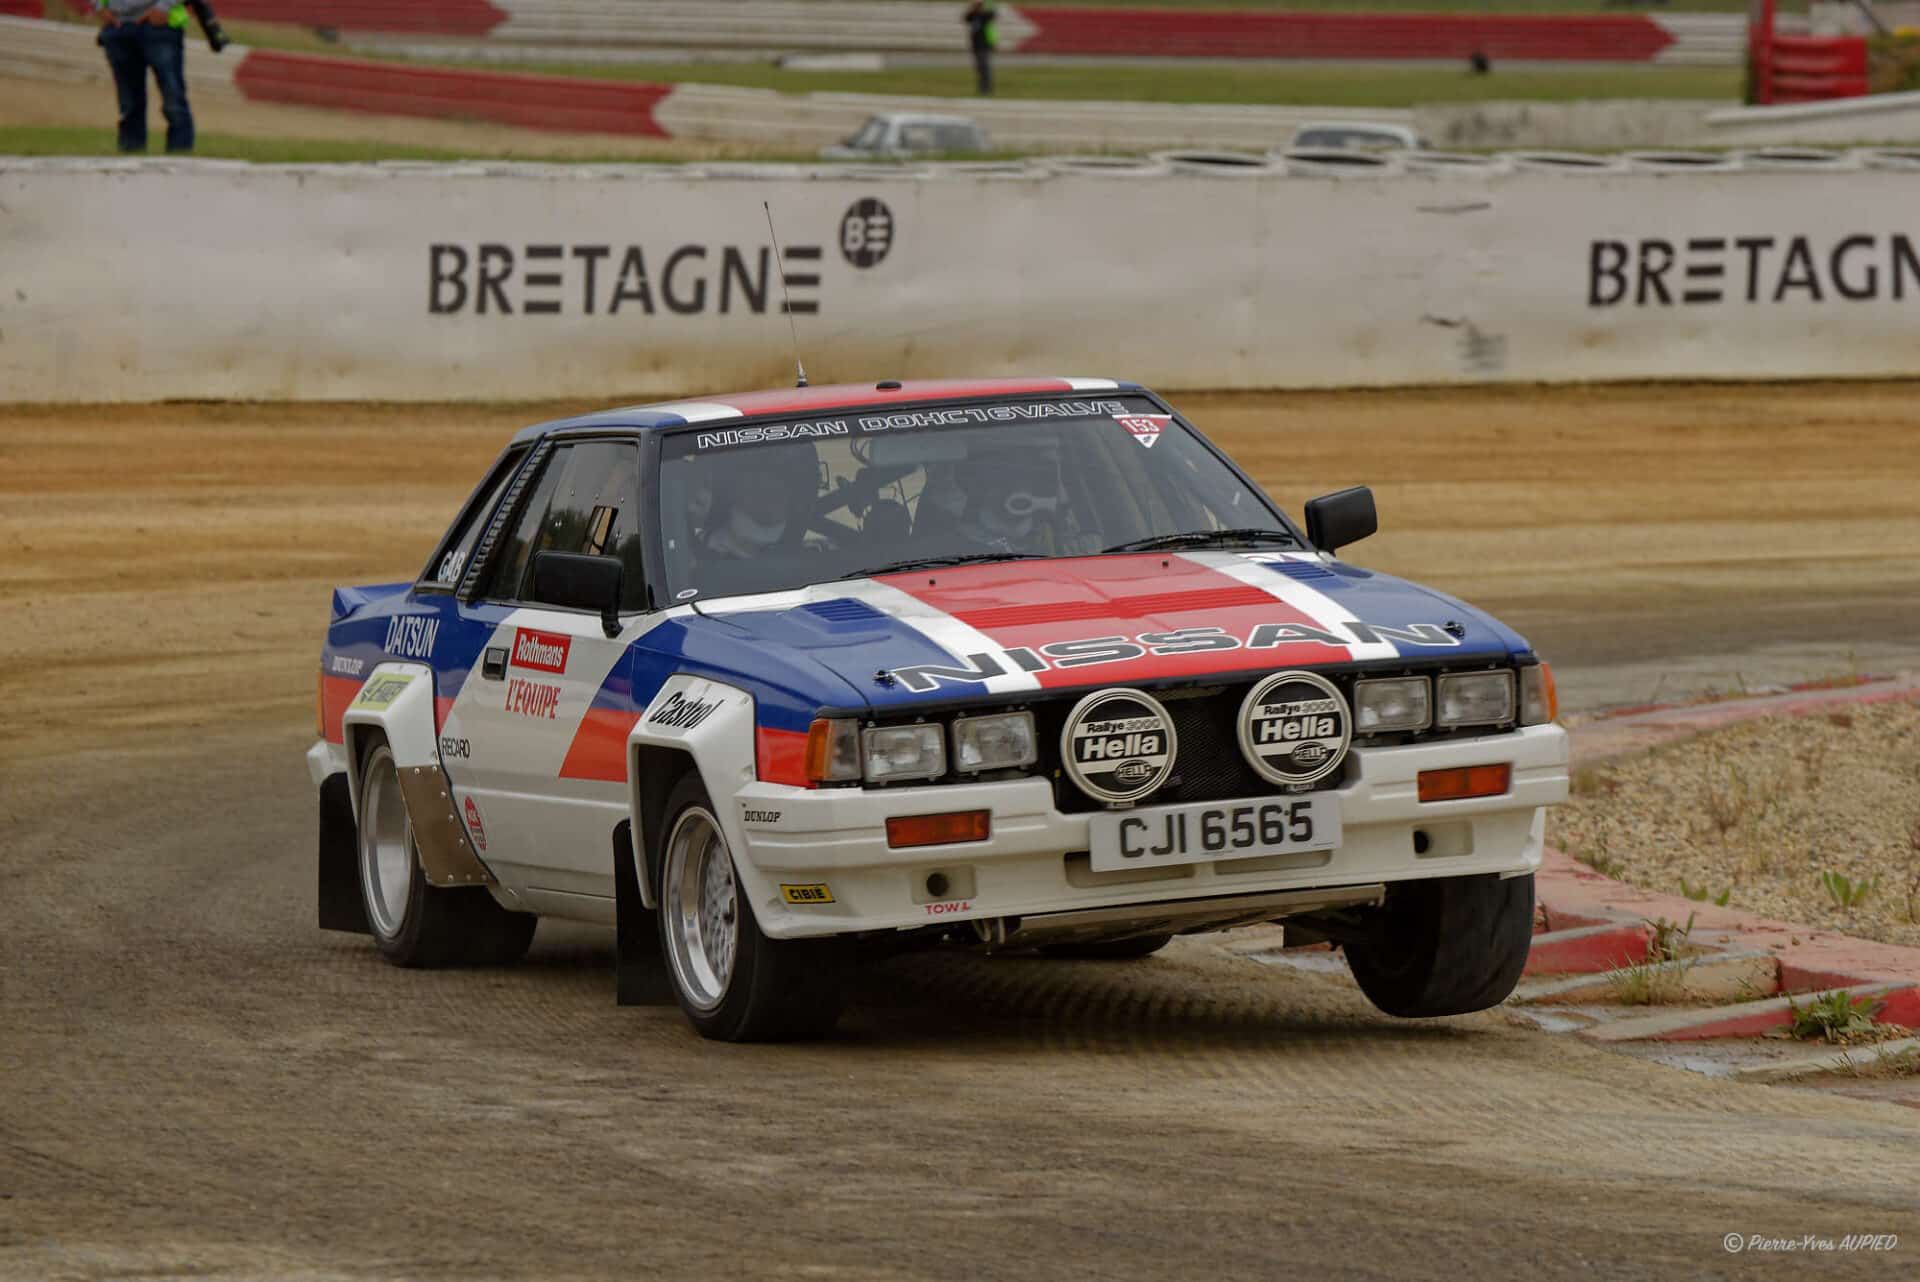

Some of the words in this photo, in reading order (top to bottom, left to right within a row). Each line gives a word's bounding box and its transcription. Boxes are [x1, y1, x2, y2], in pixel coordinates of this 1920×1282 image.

[428, 243, 822, 315] BRETAGNE
[697, 420, 849, 449] NISSAN
[1121, 418, 1161, 433] 153
[384, 615, 440, 658] DATSUN
[516, 633, 564, 668] Rothmans
[890, 622, 1464, 693] NISSAN
[505, 678, 561, 720] L'ÉQUIPE
[648, 691, 725, 729] Castrol
[1263, 704, 1301, 716] Rallye
[1086, 722, 1124, 734] Rallye
[1260, 716, 1335, 742] Hella
[442, 737, 470, 759] RECARO
[1082, 735, 1160, 760] Hella
[744, 810, 781, 823] DUNLOP
[1119, 813, 1187, 858] CJI
[1201, 801, 1313, 850] 6565
